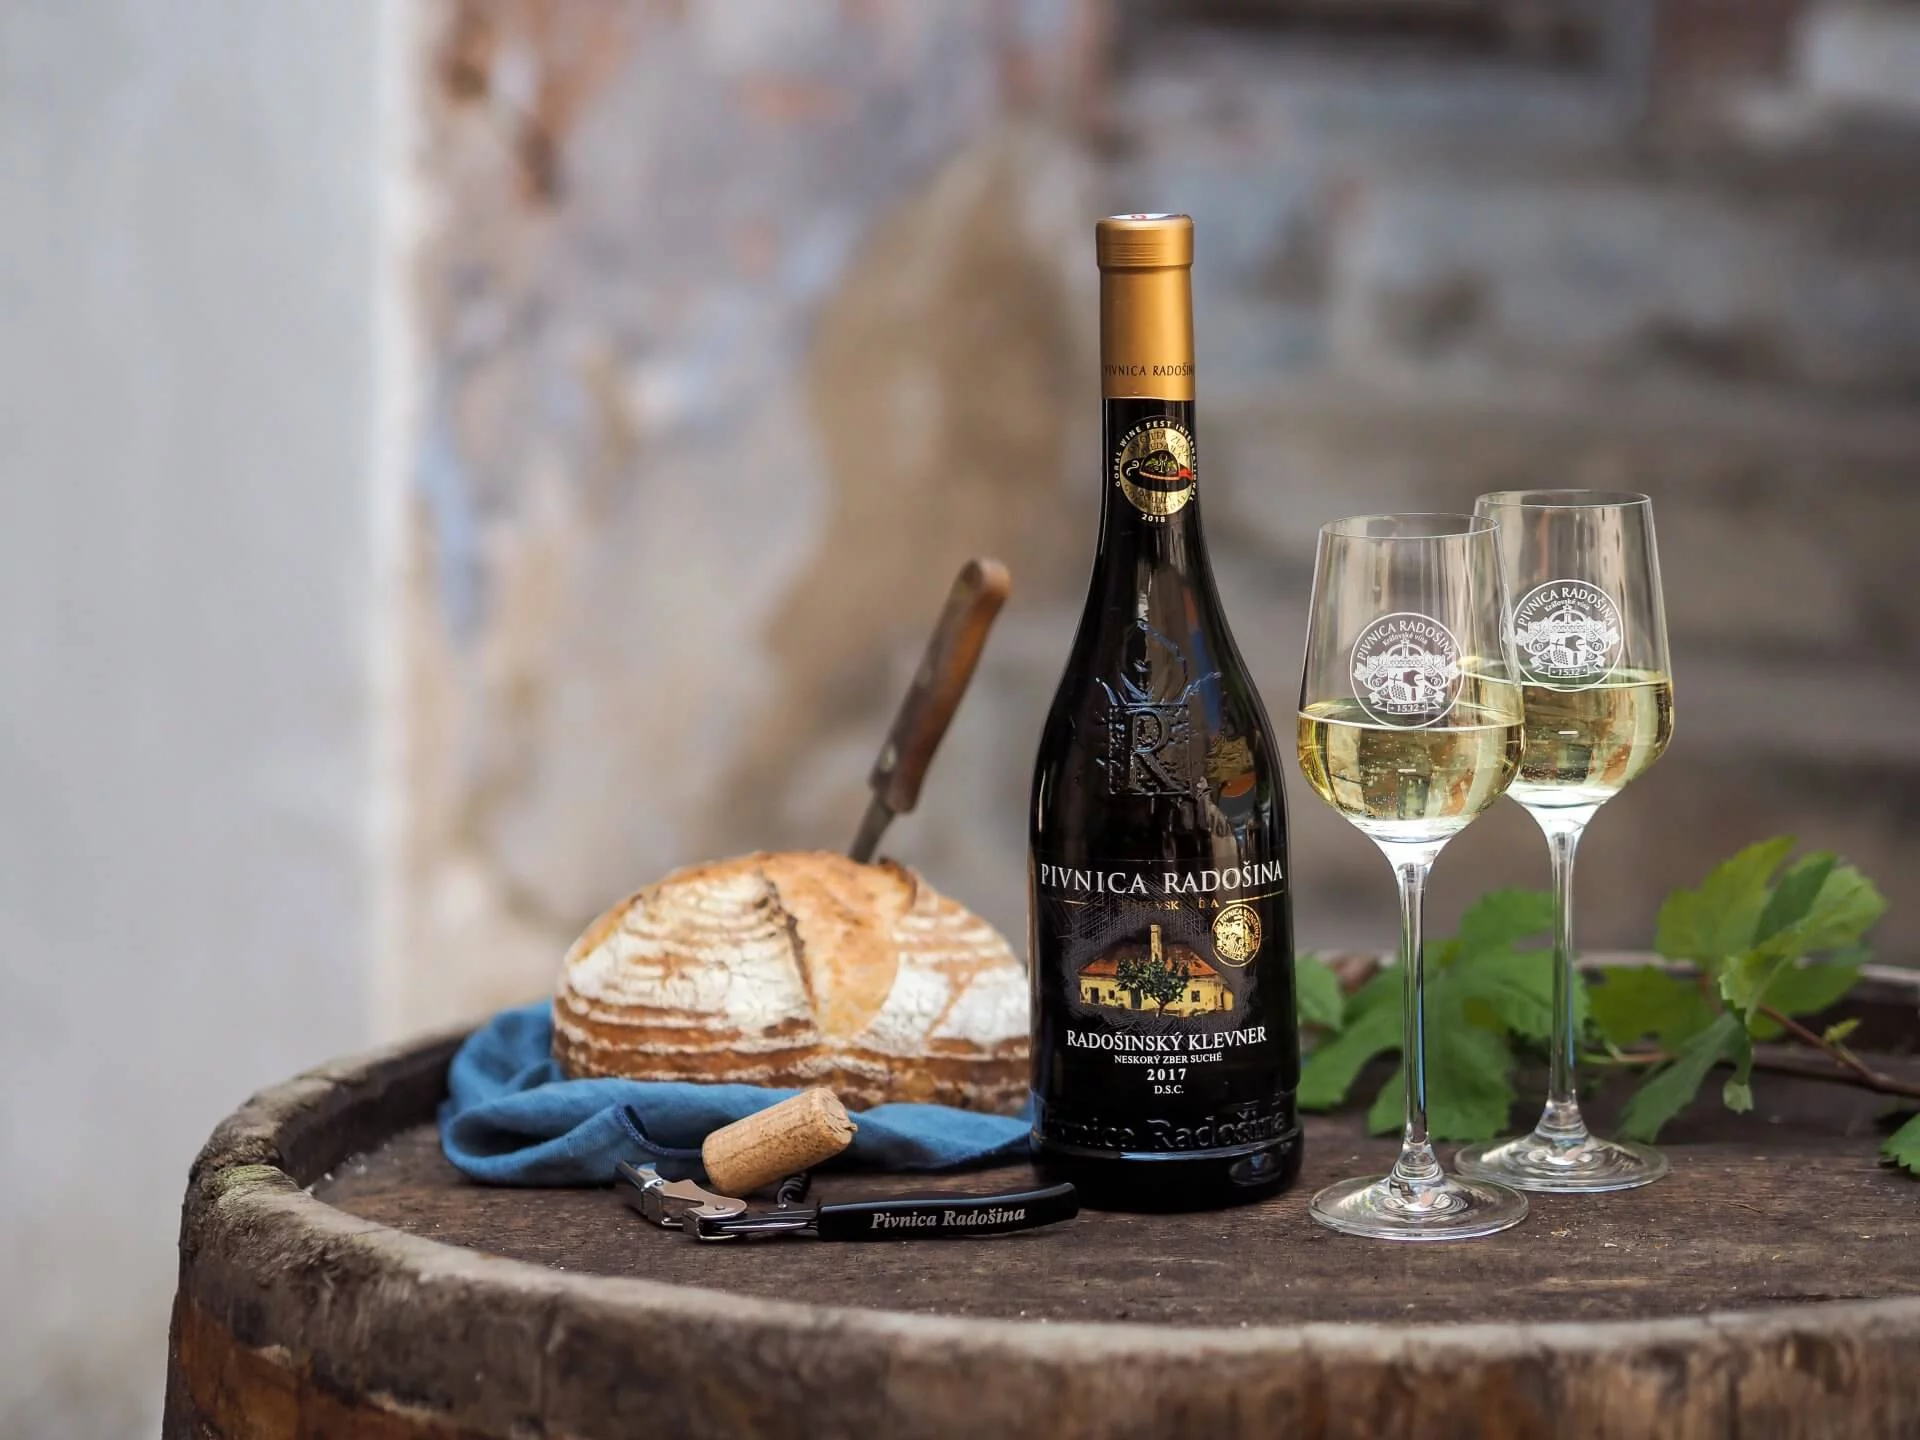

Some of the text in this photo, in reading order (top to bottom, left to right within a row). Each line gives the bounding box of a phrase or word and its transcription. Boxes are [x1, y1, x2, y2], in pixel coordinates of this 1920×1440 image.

[1152, 361, 1194, 376] RADOŠIN
[1120, 426, 1141, 447] WINE
[1141, 513, 1166, 523] 2018
[1517, 587, 1617, 626] PIVNICA RADOŠINA
[1357, 620, 1456, 661] PIVNICA RADOŠINA
[1040, 859, 1284, 895] PIVNICA RADOŠINA
[1066, 1026, 1268, 1051] RADOŠINSKÝ KLEVNER
[1114, 1051, 1223, 1064] NESKORÝ ZBER SUCHÉ
[1147, 1068, 1187, 1081] 2017
[1154, 1084, 1184, 1095] D.S.C.
[871, 1207, 1026, 1229] Pivnica Radošina
